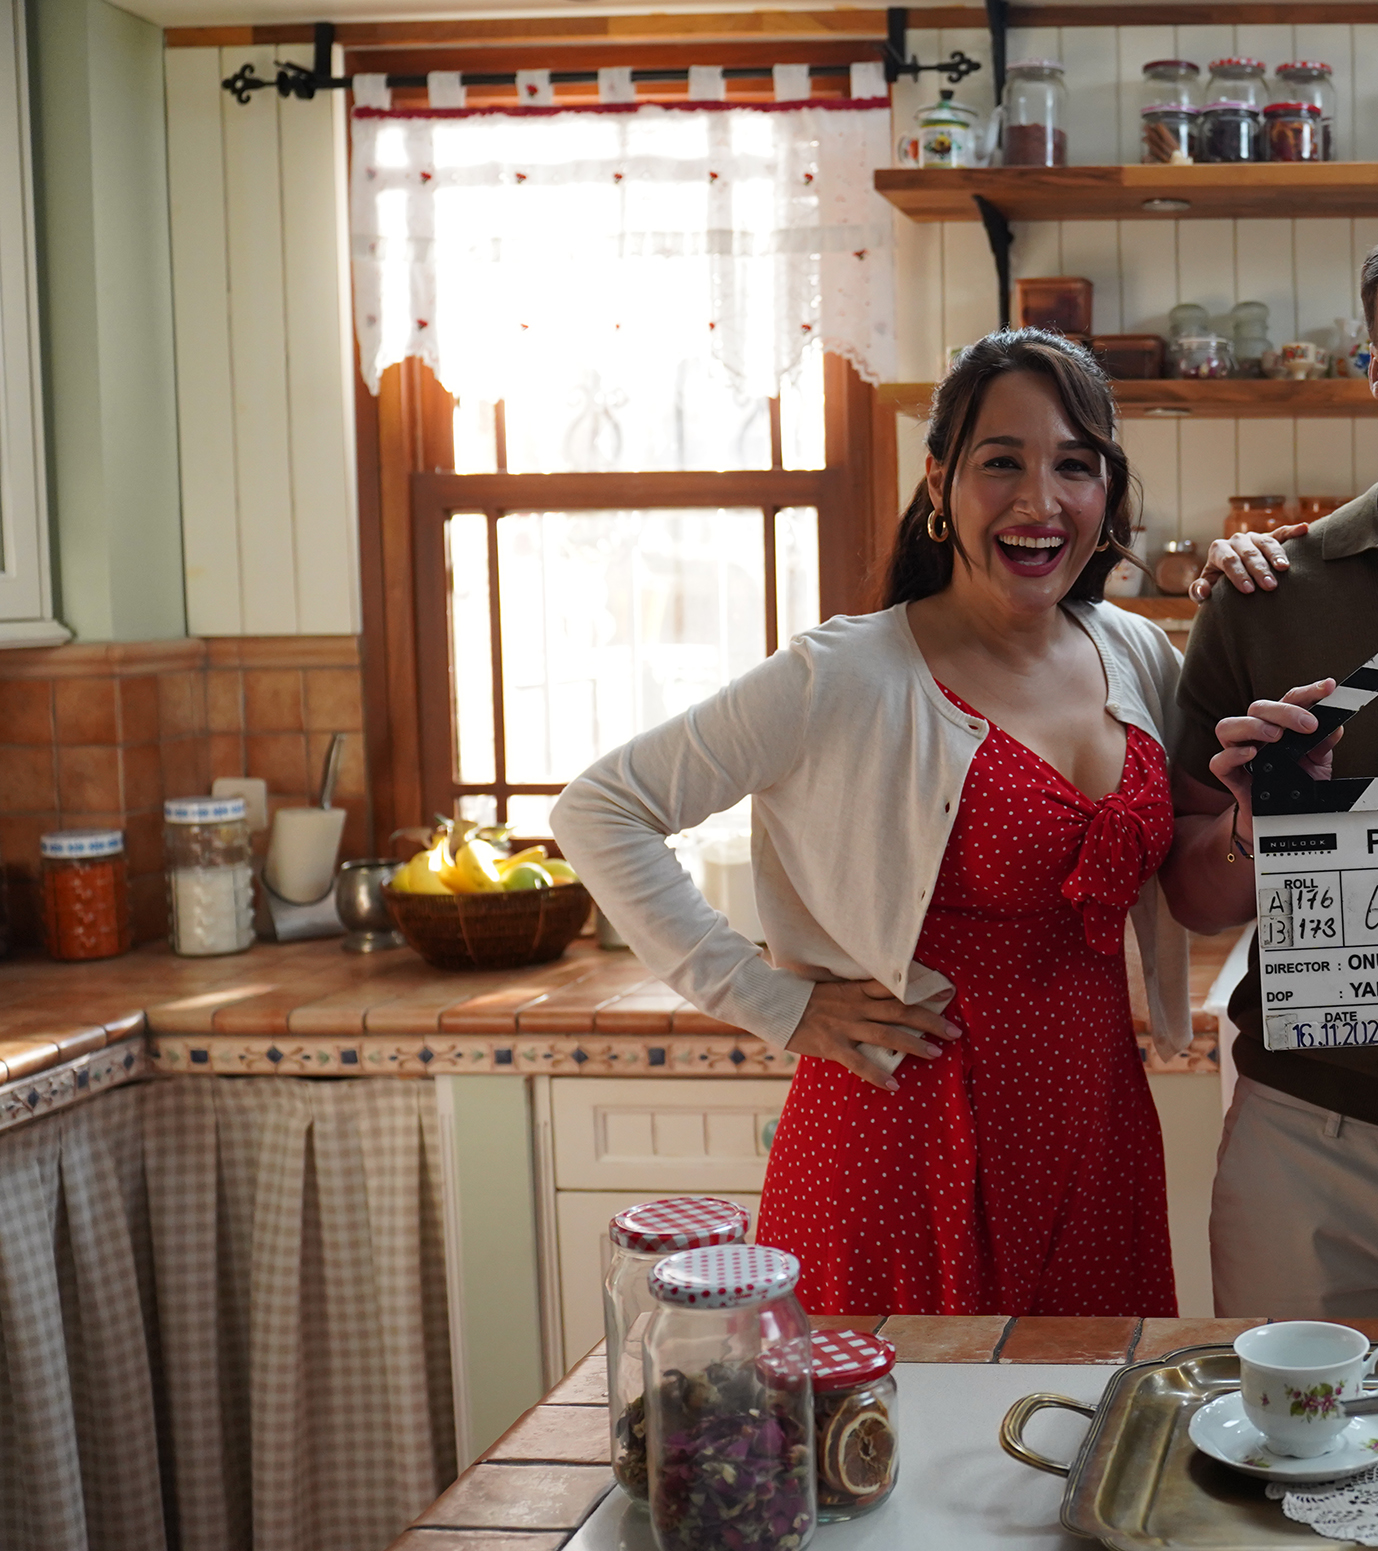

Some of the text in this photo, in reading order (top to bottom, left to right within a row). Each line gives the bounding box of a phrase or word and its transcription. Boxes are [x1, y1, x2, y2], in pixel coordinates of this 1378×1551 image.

[1284, 878, 1319, 889] ROLL
[1269, 887, 1334, 913] A 176
[1299, 917, 1337, 939] 173
[1265, 961, 1330, 975] DIRECTOR
[1266, 991, 1294, 1002] DOP
[1324, 1011, 1358, 1023] DATE
